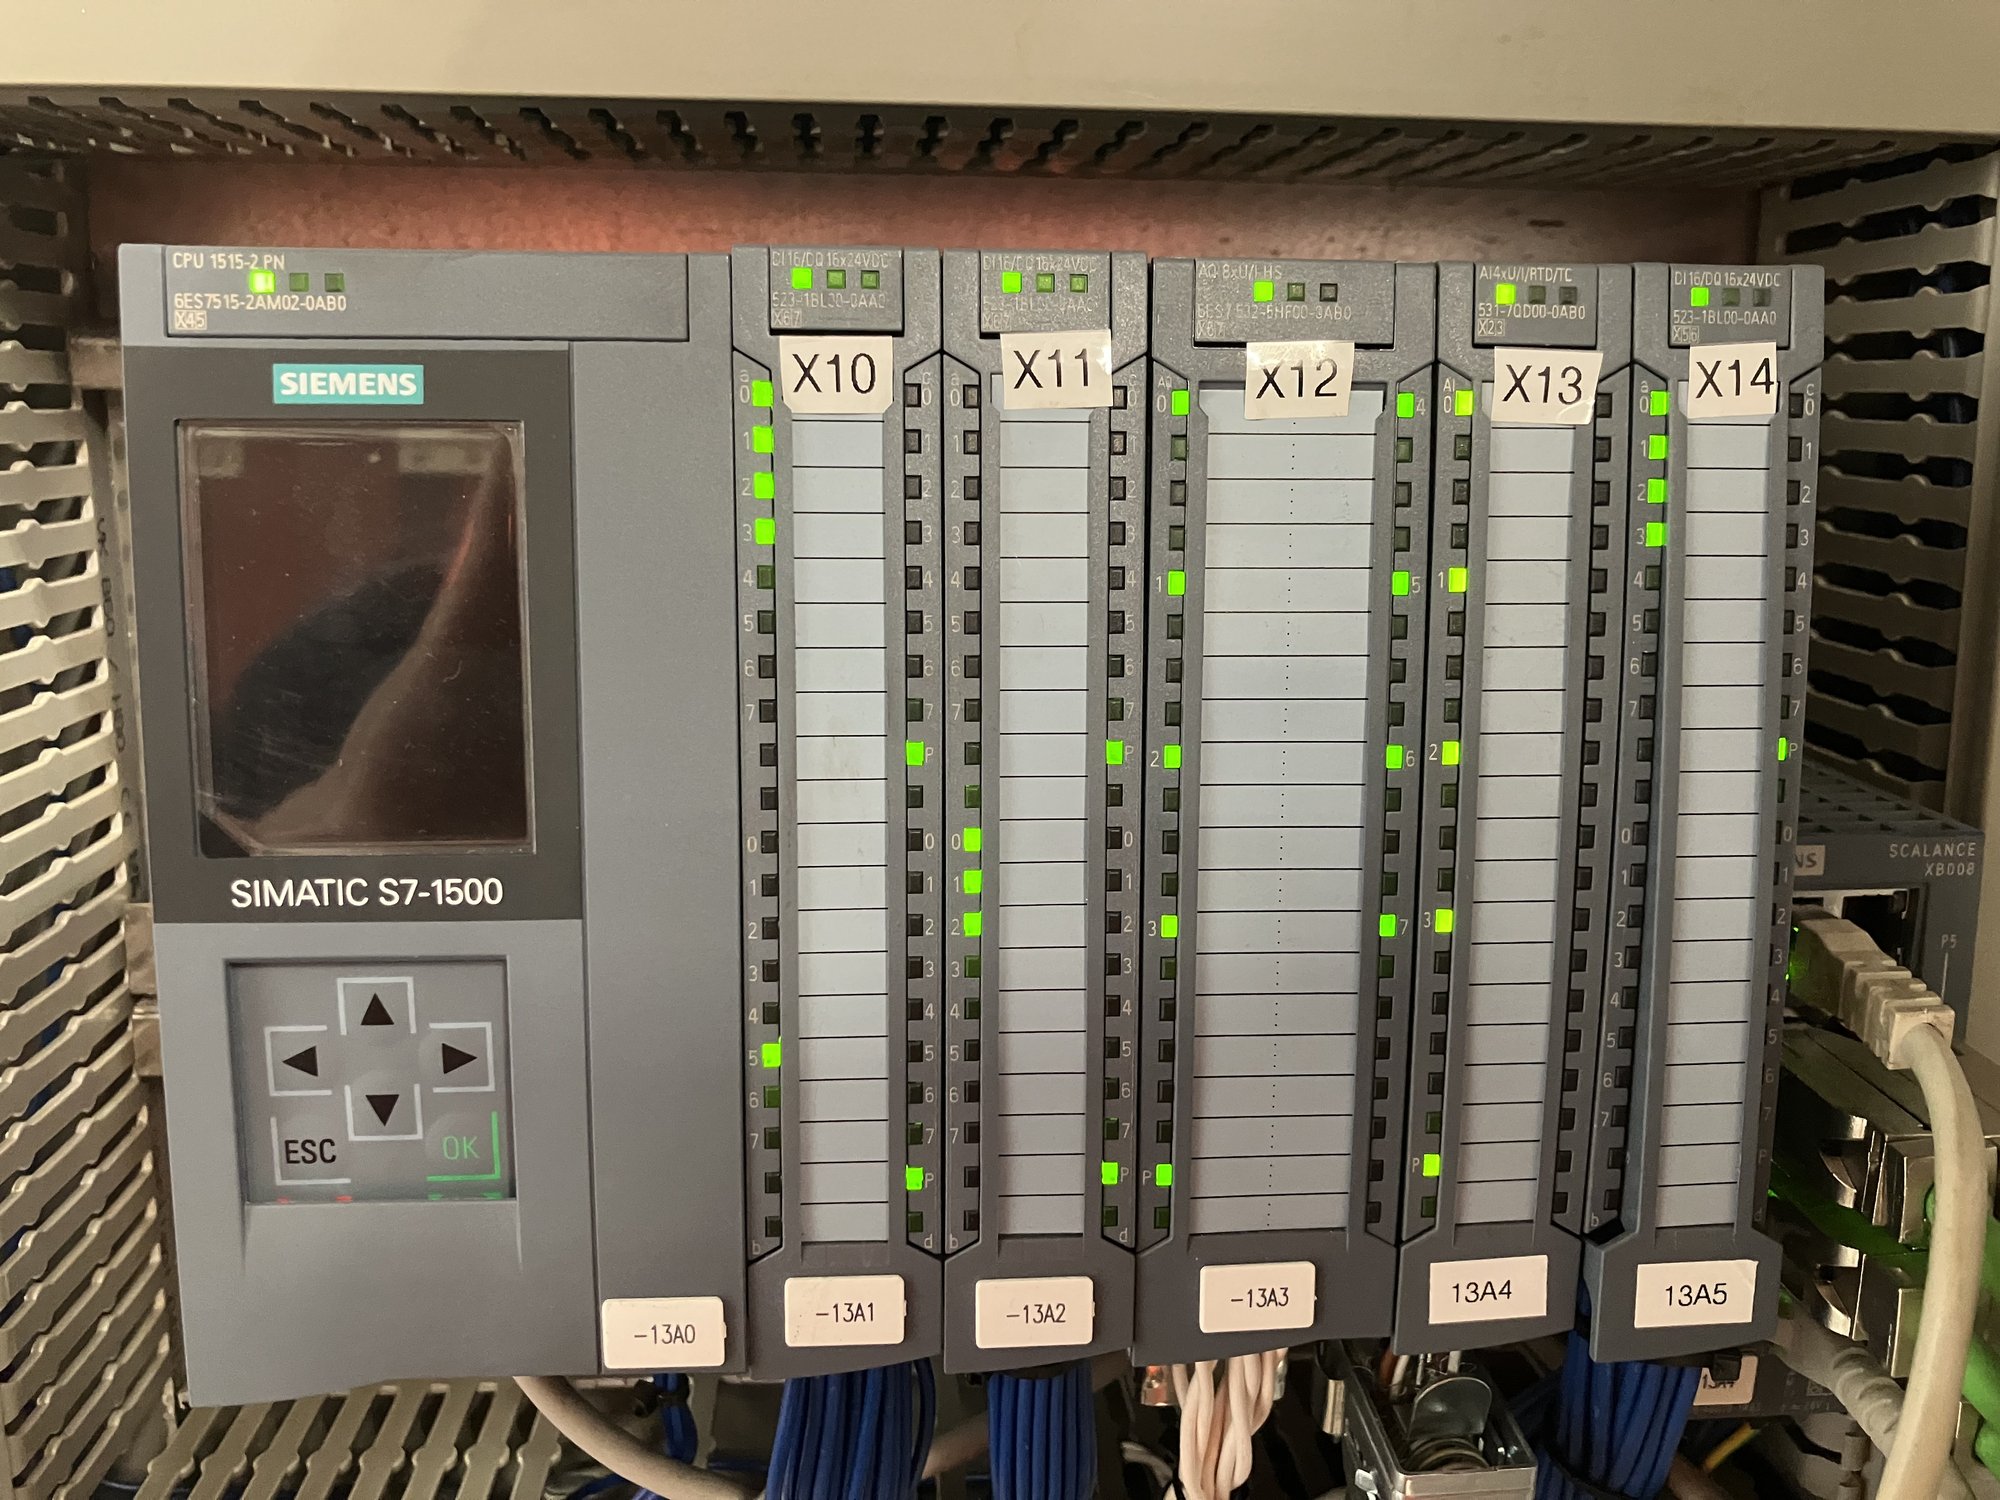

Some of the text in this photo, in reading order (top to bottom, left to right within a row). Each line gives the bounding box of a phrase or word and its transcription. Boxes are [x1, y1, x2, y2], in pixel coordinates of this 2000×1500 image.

[173, 253, 284, 270] CPU 1515-2 PN
[174, 293, 346, 311] 6ES7515-2AM02-0AB0
[1673, 310, 1777, 326] 523-1BL00-0AA0
[792, 352, 878, 394] X10
[1014, 350, 1092, 390] X11
[1696, 357, 1776, 399] X14
[280, 372, 417, 396] SIEMENS
[1256, 358, 1339, 400] X12
[1502, 364, 1582, 406] X13
[740, 385, 751, 403] 0
[950, 388, 960, 406] 0
[1157, 394, 1167, 412] 0
[1416, 398, 1426, 416] 4
[1444, 396, 1452, 413] 0
[1639, 395, 1649, 413] 0
[1806, 397, 1815, 416] 0
[744, 432, 750, 449] 1
[953, 435, 959, 452] 1
[1640, 440, 1646, 456] 1
[1806, 442, 1812, 458] 1
[742, 478, 752, 496] 2
[951, 481, 960, 498] 2
[1638, 484, 1646, 501] 2
[1802, 486, 1810, 503] 2
[743, 524, 752, 541] 3
[952, 526, 961, 543] 3
[1636, 528, 1645, 545] 3
[1801, 529, 1809, 545] 3
[743, 570, 754, 587] 4
[950, 571, 960, 587] 4
[1156, 576, 1162, 592] 1
[1411, 576, 1421, 593] 5
[1438, 571, 1444, 589] 1
[1633, 571, 1643, 587] 4
[1798, 572, 1807, 588] 4
[744, 615, 754, 631] 5
[924, 615, 932, 631] 5
[951, 616, 960, 632] 5
[1126, 614, 1135, 631] 5
[1633, 614, 1641, 631] 5
[1796, 615, 1804, 631] 5
[744, 660, 754, 677] 6
[924, 660, 933, 676] 6
[951, 660, 961, 677] 6
[1126, 658, 1134, 675] 6
[1630, 658, 1639, 675] 6
[1794, 658, 1802, 675] 6
[745, 704, 755, 720] 7
[924, 703, 933, 719] 7
[952, 703, 961, 720] 7
[1629, 701, 1638, 717] 7
[1792, 701, 1800, 717] 7
[1150, 751, 1159, 767] 2
[1406, 750, 1415, 767] 6
[1428, 744, 1438, 760] 2
[925, 833, 934, 849] 0
[951, 833, 961, 850] 0
[1124, 832, 1133, 847] 0
[1622, 828, 1630, 843] 0
[1783, 826, 1792, 841] 0
[747, 836, 757, 853] 0
[1889, 842, 1976, 858] SCALANCE
[1126, 874, 1131, 889] 1
[1621, 870, 1627, 885] 1
[1783, 868, 1788, 882] 1
[750, 879, 756, 895] 1
[927, 876, 933, 892] 1
[953, 876, 959, 892] 1
[230, 877, 503, 908] SIMATIC S7-1500
[1124, 916, 1132, 932] 2
[1424, 912, 1431, 927] 3
[1616, 912, 1626, 927] 2
[1777, 910, 1785, 924] 2
[748, 923, 757, 939] 2
[925, 919, 934, 935] 2
[951, 919, 960, 935] 2
[1148, 921, 1157, 936] 3
[1400, 919, 1408, 934] 7
[1941, 934, 1958, 949] P5
[1615, 952, 1622, 967] 3
[1774, 949, 1782, 964] 3
[749, 966, 758, 981] 3
[925, 961, 935, 977] 3
[951, 961, 960, 977] 3
[1124, 958, 1132, 973] 3
[1610, 992, 1619, 1007] 4
[749, 1008, 758, 1024] 4
[925, 1003, 935, 1019] 4
[950, 1004, 960, 1019] 4
[1122, 1000, 1132, 1016] 4
[1122, 1041, 1131, 1056] 5
[1607, 1033, 1616, 1048] 5
[749, 1050, 758, 1066] 5
[925, 1045, 933, 1061] 5
[950, 1045, 959, 1061] 5
[1603, 1073, 1612, 1088] 6
[925, 1087, 934, 1102] 6
[950, 1086, 959, 1103] 6
[1122, 1082, 1130, 1098] 6
[749, 1092, 759, 1108] 6
[1601, 1111, 1609, 1126] 7
[926, 1128, 935, 1144] 7
[950, 1128, 958, 1144] 7
[1122, 1123, 1130, 1138] 7
[442, 1136, 480, 1160] OK
[750, 1133, 758, 1149] 7
[284, 1138, 336, 1164] ESC
[1230, 1287, 1290, 1309] -13A3
[1451, 1280, 1513, 1304] 13A4
[1665, 1282, 1728, 1307] 13A5
[815, 1302, 876, 1324] -13A1
[1006, 1302, 1067, 1324] -13A2
[634, 1324, 696, 1345] -13A0
